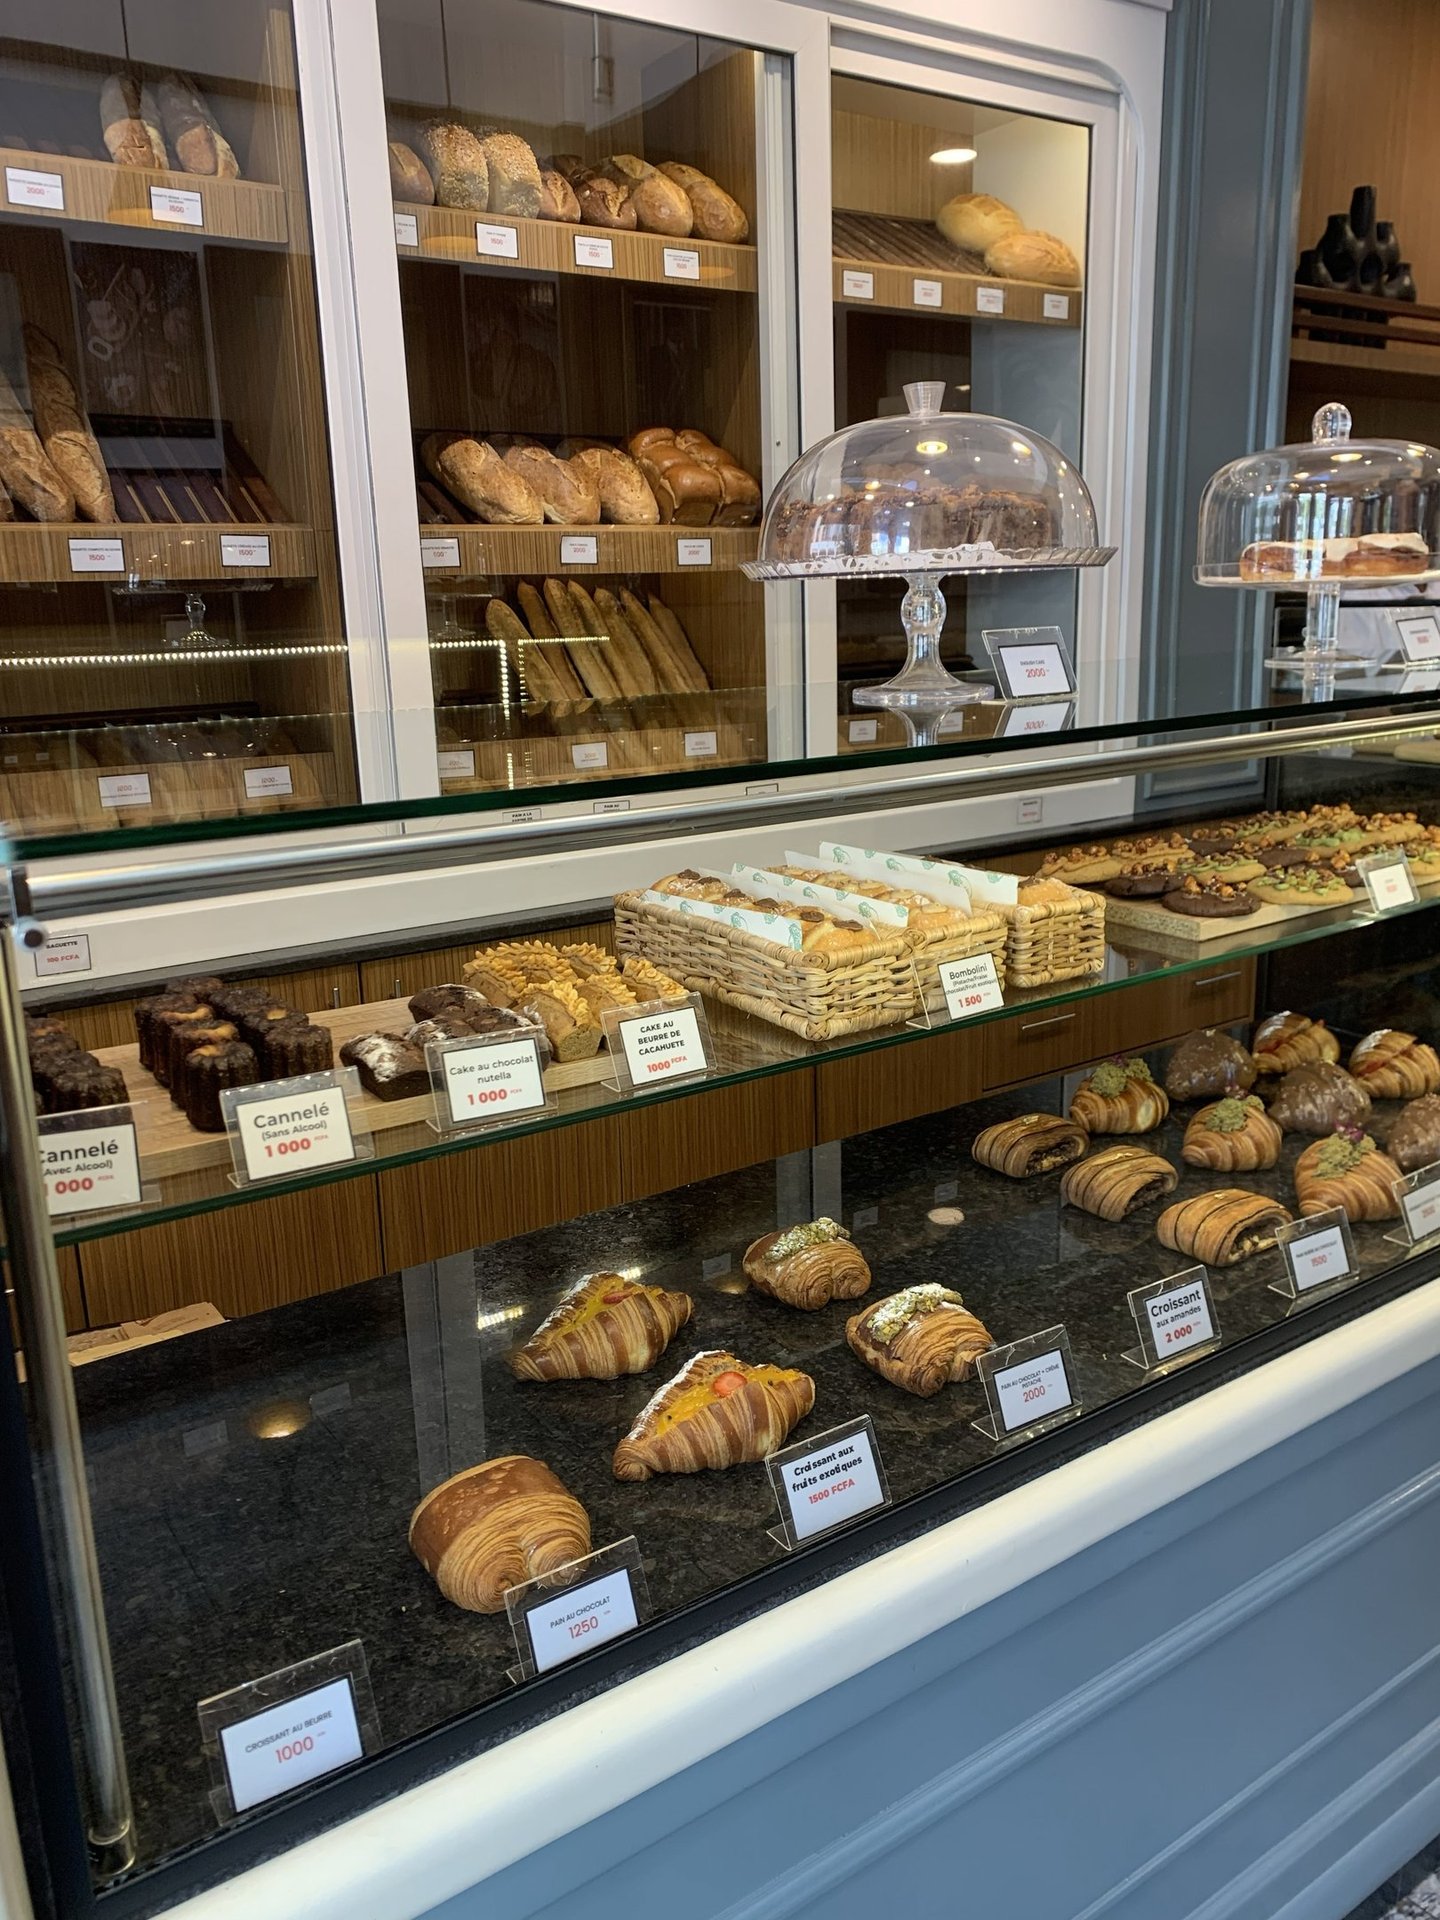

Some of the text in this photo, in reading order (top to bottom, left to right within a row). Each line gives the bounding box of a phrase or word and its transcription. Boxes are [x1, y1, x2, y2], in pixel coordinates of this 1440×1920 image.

[169, 205, 185, 213] 1500
[1025, 667, 1046, 678] 2000
[60, 954, 80, 962] FCFA
[949, 963, 988, 980] Bombolini
[965, 994, 982, 1007] 500
[640, 1020, 674, 1034] CAKE AU
[638, 1029, 681, 1045] BEURRE DE
[639, 1040, 685, 1056] CACAHUETE
[449, 1055, 534, 1076] Cake au chocolat
[647, 1055, 688, 1073] 1000 FCFA
[477, 1071, 512, 1085] nutella
[478, 1088, 508, 1104] 000
[253, 1101, 330, 1129] Cannelé
[261, 1120, 328, 1141] (Sans Alcool)
[278, 1138, 311, 1155] 000
[75, 1160, 113, 1173] Alcool)
[55, 1177, 94, 1195] 000
[1151, 1289, 1202, 1318] Croissant
[1156, 1305, 1202, 1329] aux amandes
[1165, 1325, 1193, 1344] 2 000
[1001, 1382, 1012, 1391] PAIN
[1012, 1380, 1019, 1388] AU
[1018, 1369, 1041, 1385] CHOCOLAT
[1021, 1377, 1042, 1390] PISTACHE
[1022, 1385, 1046, 1403] 2000
[794, 1444, 855, 1477] Croissant aux
[792, 1455, 863, 1493] fruits exotiques
[808, 1477, 856, 1505] 1500 FCFA
[550, 1618, 565, 1629] PAIN
[565, 1611, 575, 1621] AU
[575, 1596, 611, 1617] CHOCOLAT
[568, 1615, 599, 1639] 1250
[245, 1710, 333, 1754] CROISSANT AU BEURRE
[275, 1735, 315, 1764] 1000
